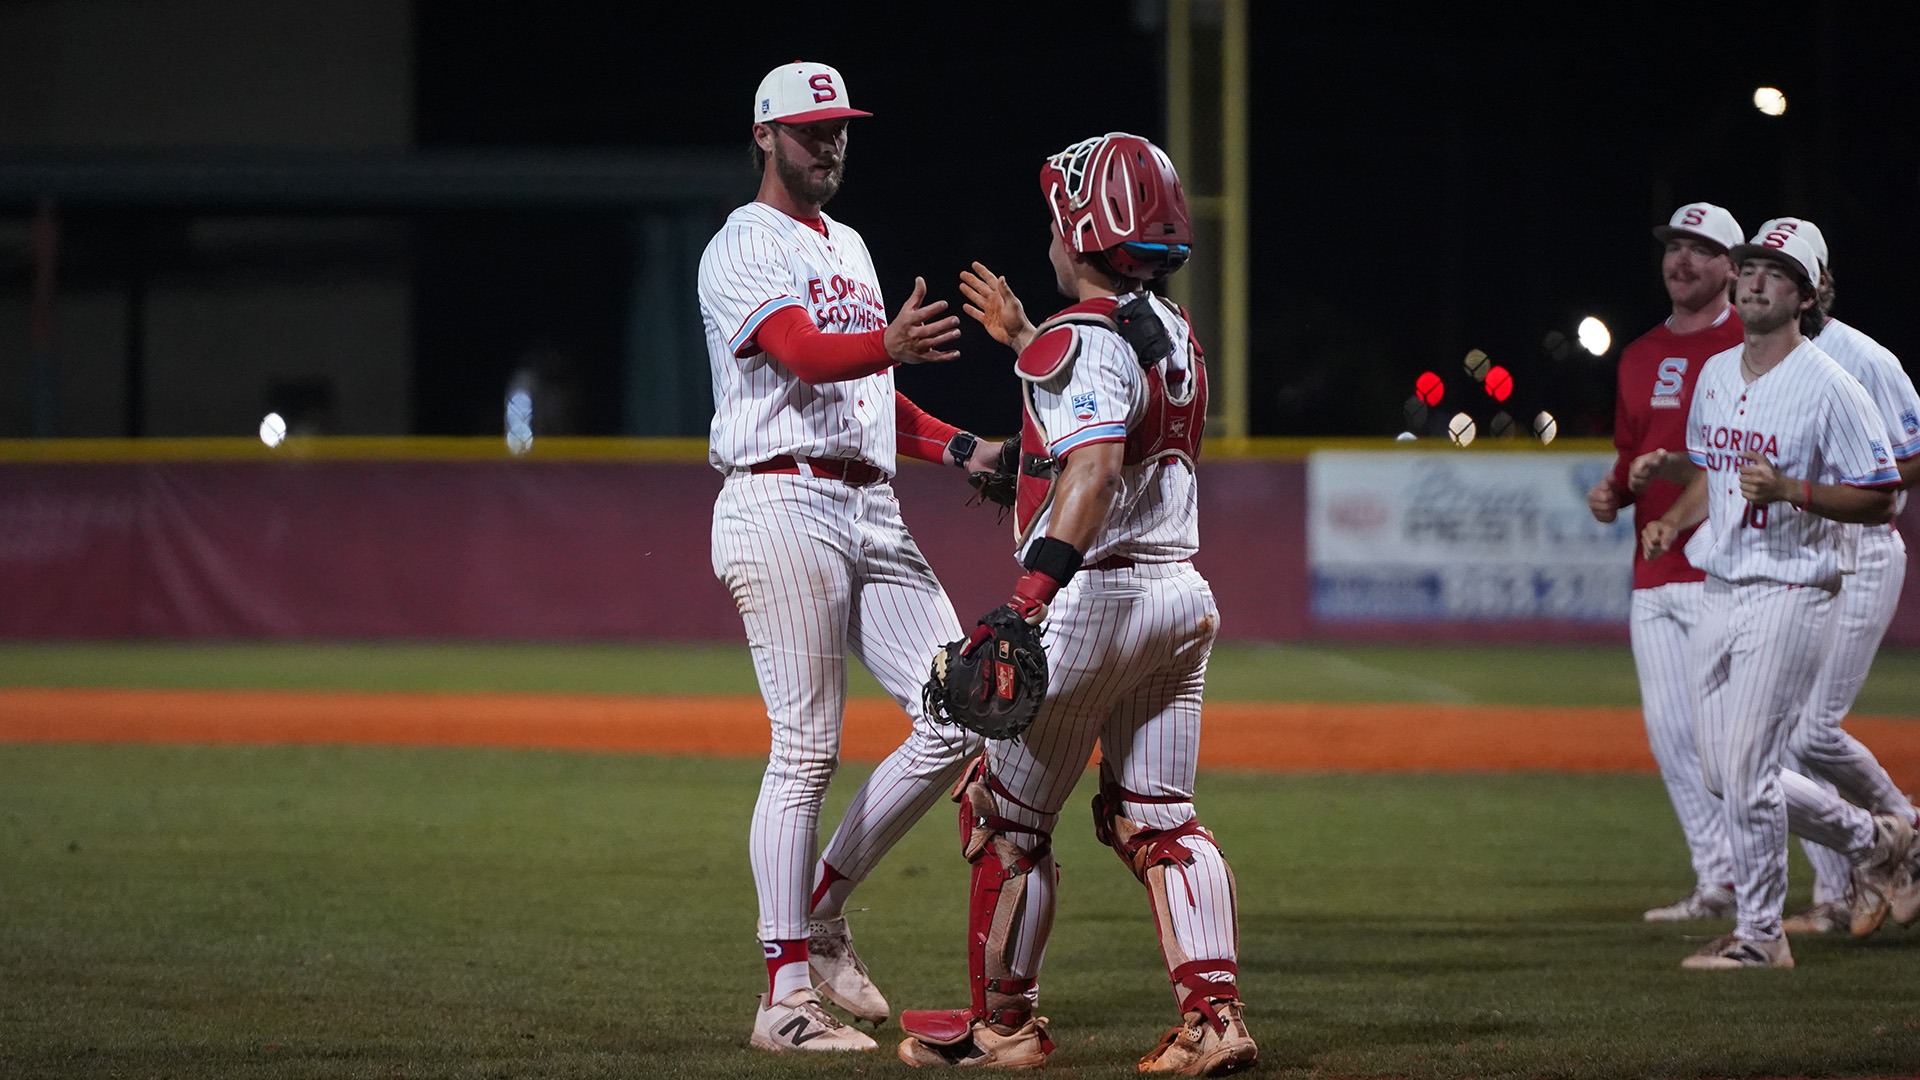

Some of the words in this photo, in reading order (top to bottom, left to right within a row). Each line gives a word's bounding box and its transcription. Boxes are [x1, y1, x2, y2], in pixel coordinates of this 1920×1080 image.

[808, 74, 837, 103] S
[1682, 208, 1706, 226] S
[1762, 231, 1789, 249] S
[1653, 357, 1688, 396] S
[1074, 394, 1094, 404] SSC
